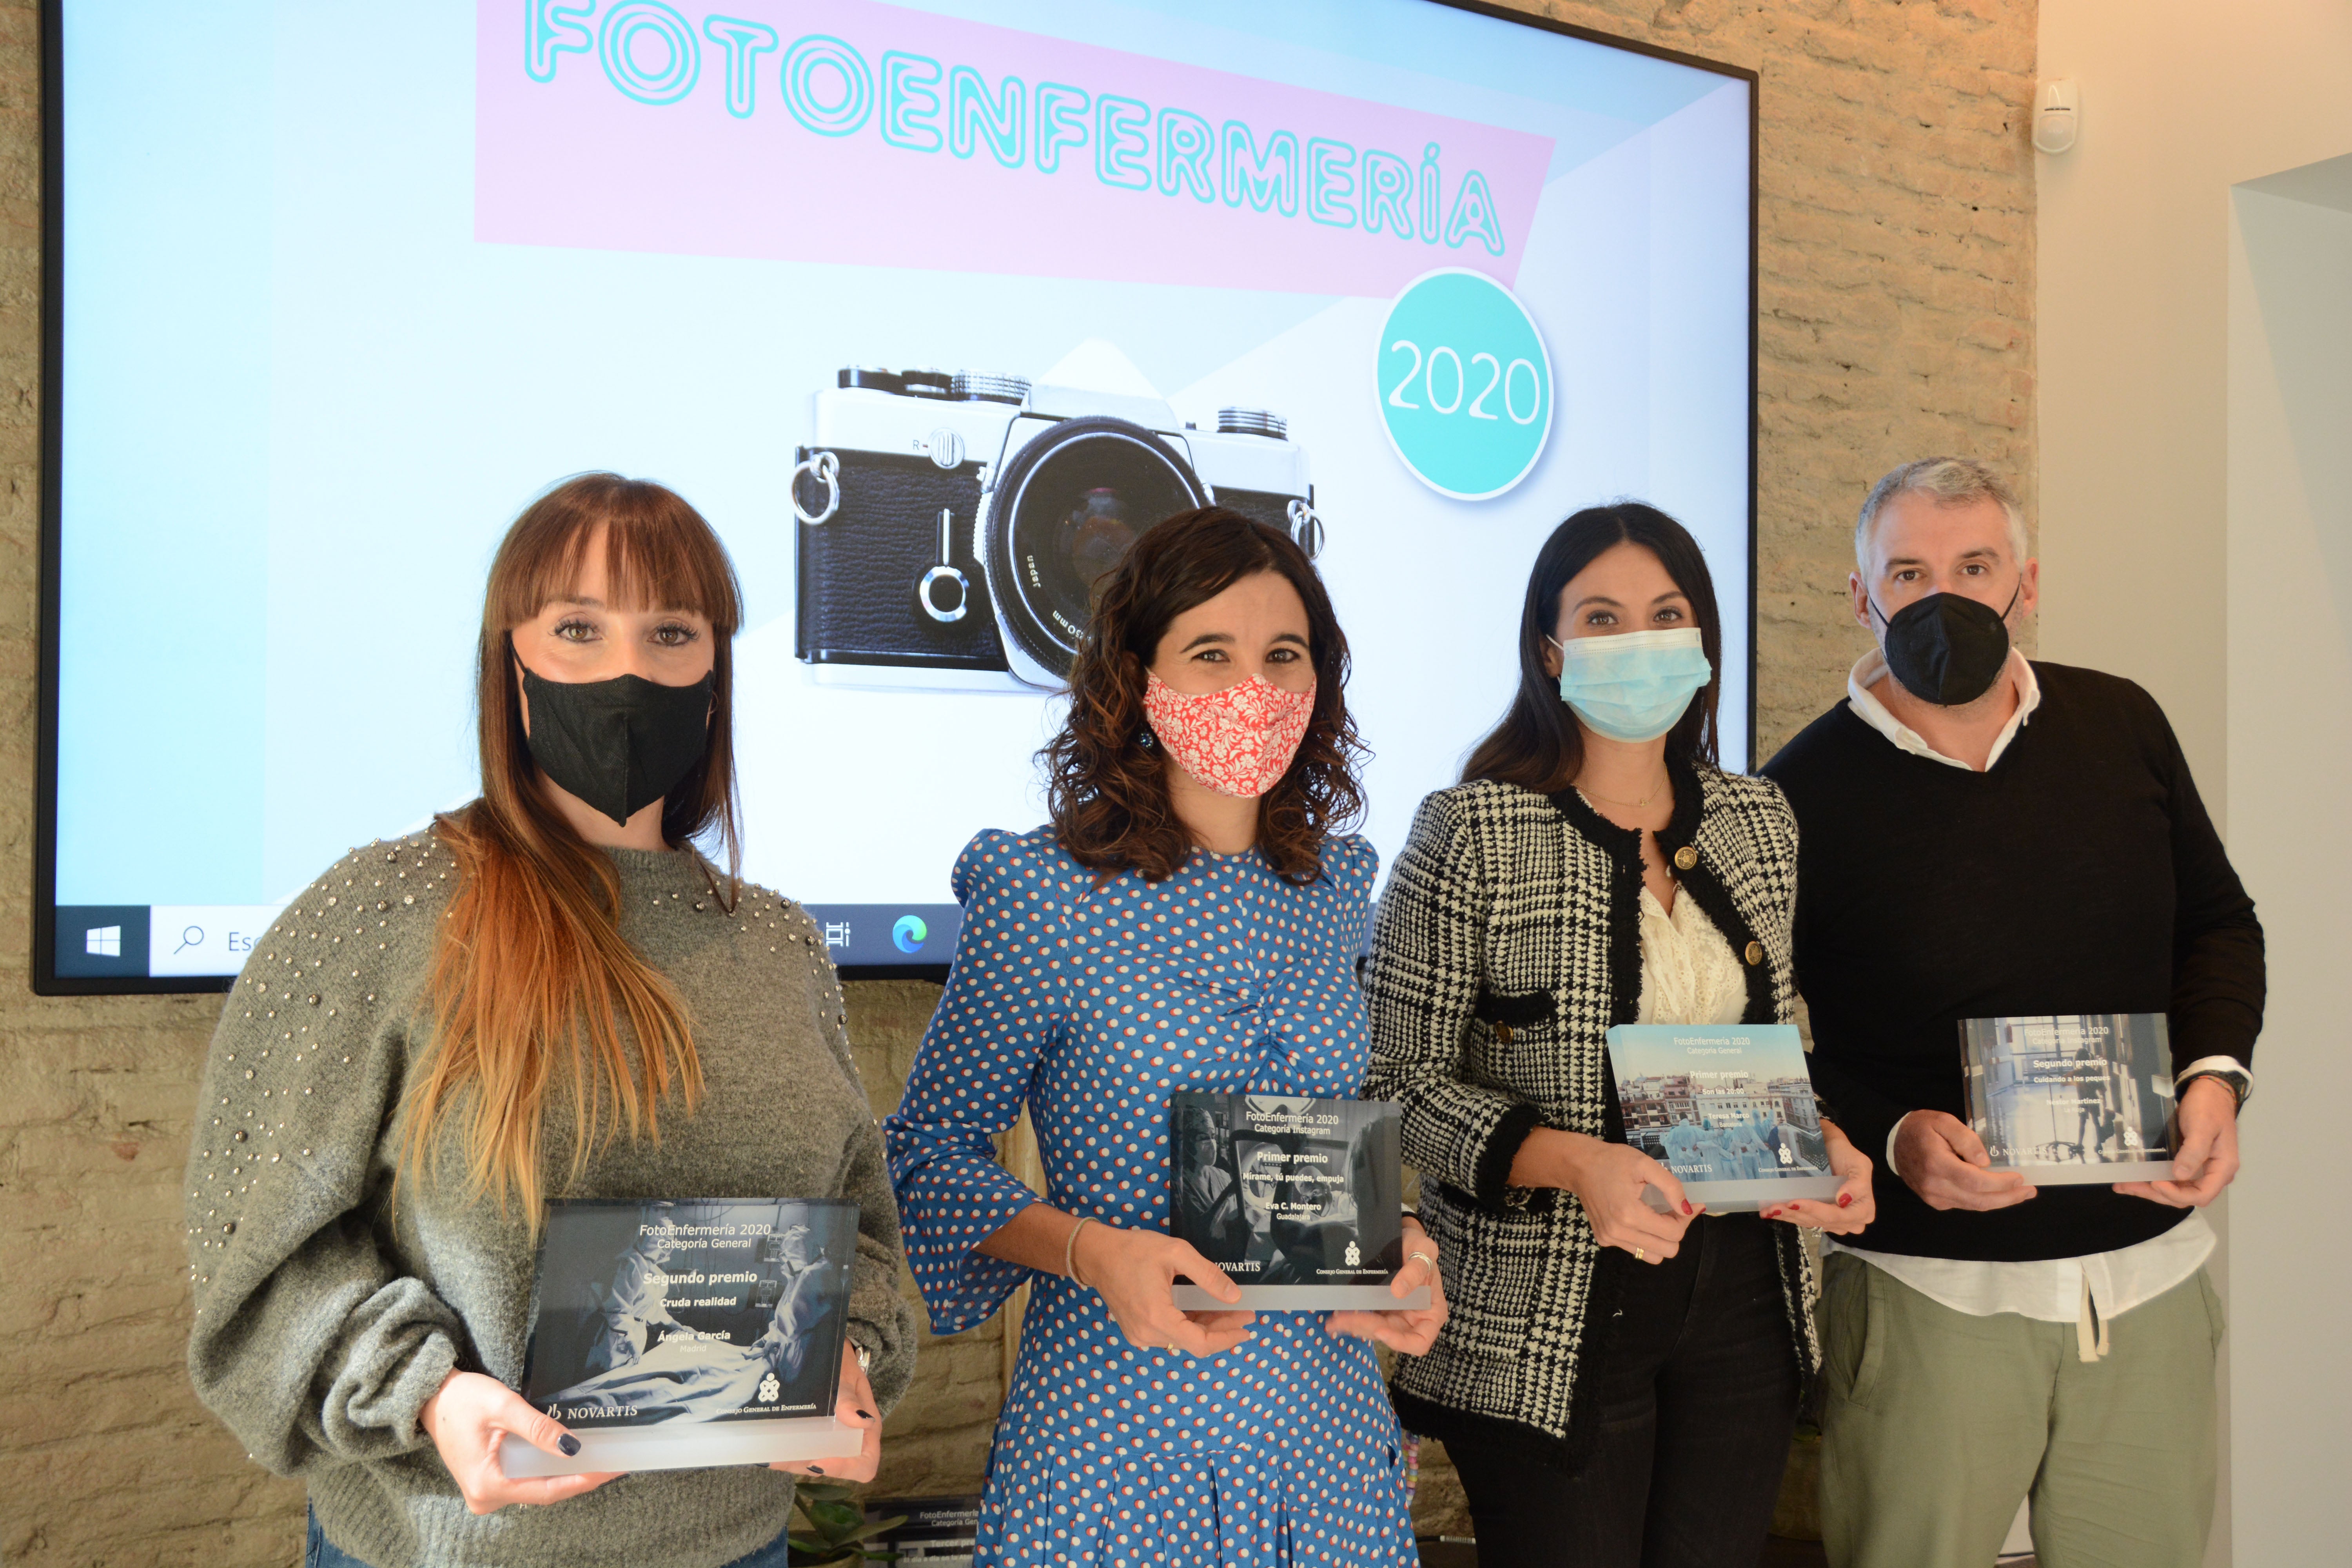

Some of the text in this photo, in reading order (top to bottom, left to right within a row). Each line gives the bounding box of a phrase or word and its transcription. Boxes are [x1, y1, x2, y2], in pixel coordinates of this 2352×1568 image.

[524, 0, 1505, 257] FOTOENFERMERÍA
[1388, 339, 1532, 425] 2020
[913, 439, 919, 450] R
[1674, 1037, 1730, 1045] FotoEnfermería
[2033, 1058, 2107, 1069] Segundo premio
[1720, 1070, 1748, 1080] premio
[1246, 1111, 1338, 1124] FotoEnfermería 2020
[1255, 1123, 1330, 1136] Categoría Instagram
[1257, 1152, 1328, 1164] Primer premio
[1671, 1165, 1712, 1173] NOVARTIS
[1243, 1172, 1273, 1181] Mírame,
[1285, 1174, 1314, 1183] puedes,
[1317, 1175, 1344, 1183] empuja
[640, 1223, 771, 1235] FotoEnfermería 2020
[658, 1238, 751, 1250] Categoría General
[1215, 1262, 1260, 1271] OVARTIS
[644, 1271, 757, 1286] Segundo premio
[660, 1297, 736, 1307] Cruda realidad
[657, 1330, 730, 1343] Ángela García
[568, 1405, 637, 1419] NOVARTIS
